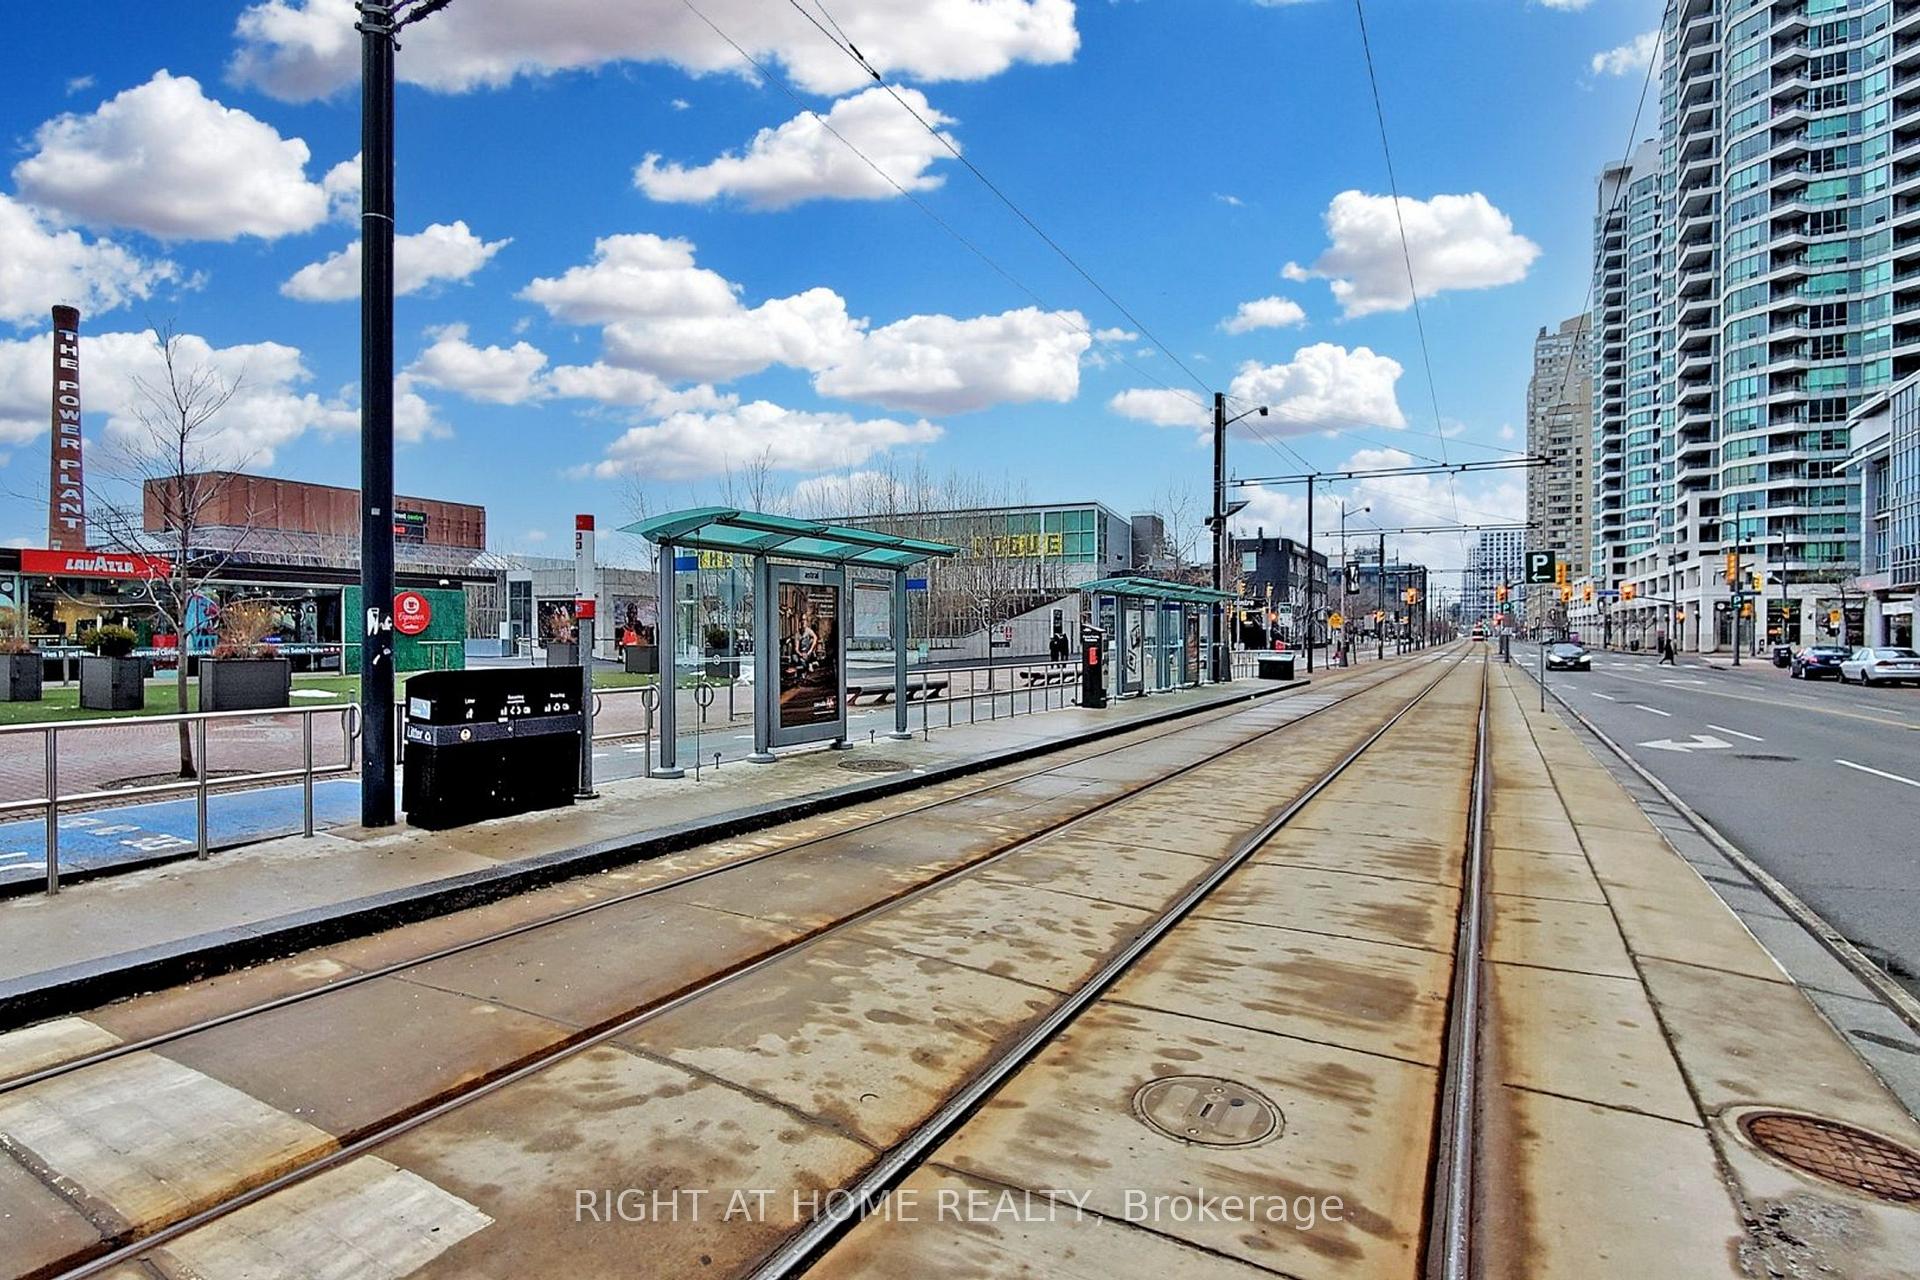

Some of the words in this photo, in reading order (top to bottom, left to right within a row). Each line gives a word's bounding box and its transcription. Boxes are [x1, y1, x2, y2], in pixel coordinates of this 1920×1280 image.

[58, 329, 78, 371] THE
[59, 380, 81, 450] POWER
[60, 459, 82, 529] PLANT
[65, 555, 135, 574] LAVAZZA
[1532, 554, 1548, 572] P
[1503, 603, 1510, 611] P
[407, 725, 424, 740] Litter
